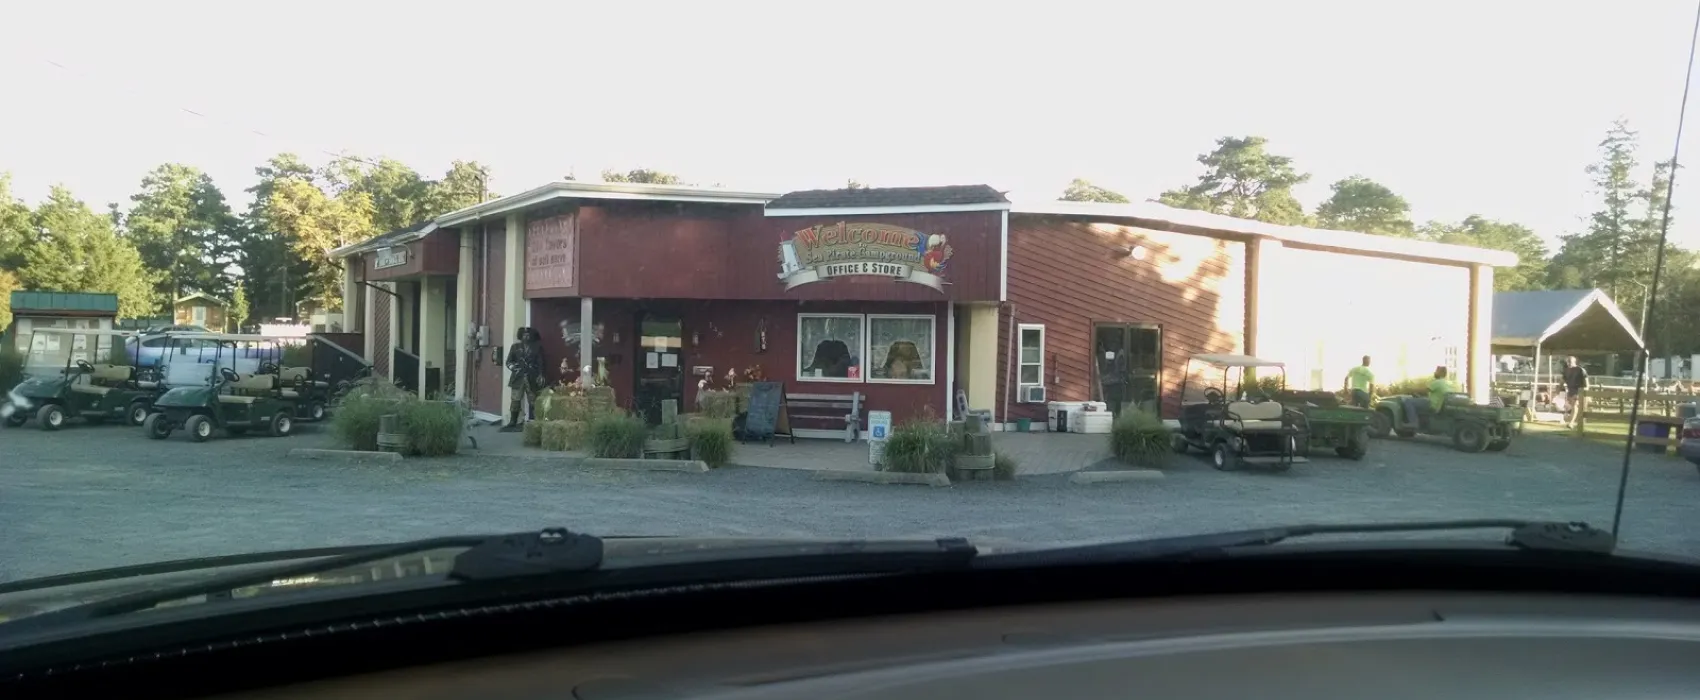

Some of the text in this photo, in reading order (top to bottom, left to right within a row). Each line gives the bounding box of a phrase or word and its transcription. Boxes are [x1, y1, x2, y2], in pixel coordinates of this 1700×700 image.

[795, 220, 919, 250] Welcome
[806, 247, 921, 264] Sea Pirate Campground
[826, 262, 902, 276] OFFICE & STORE
